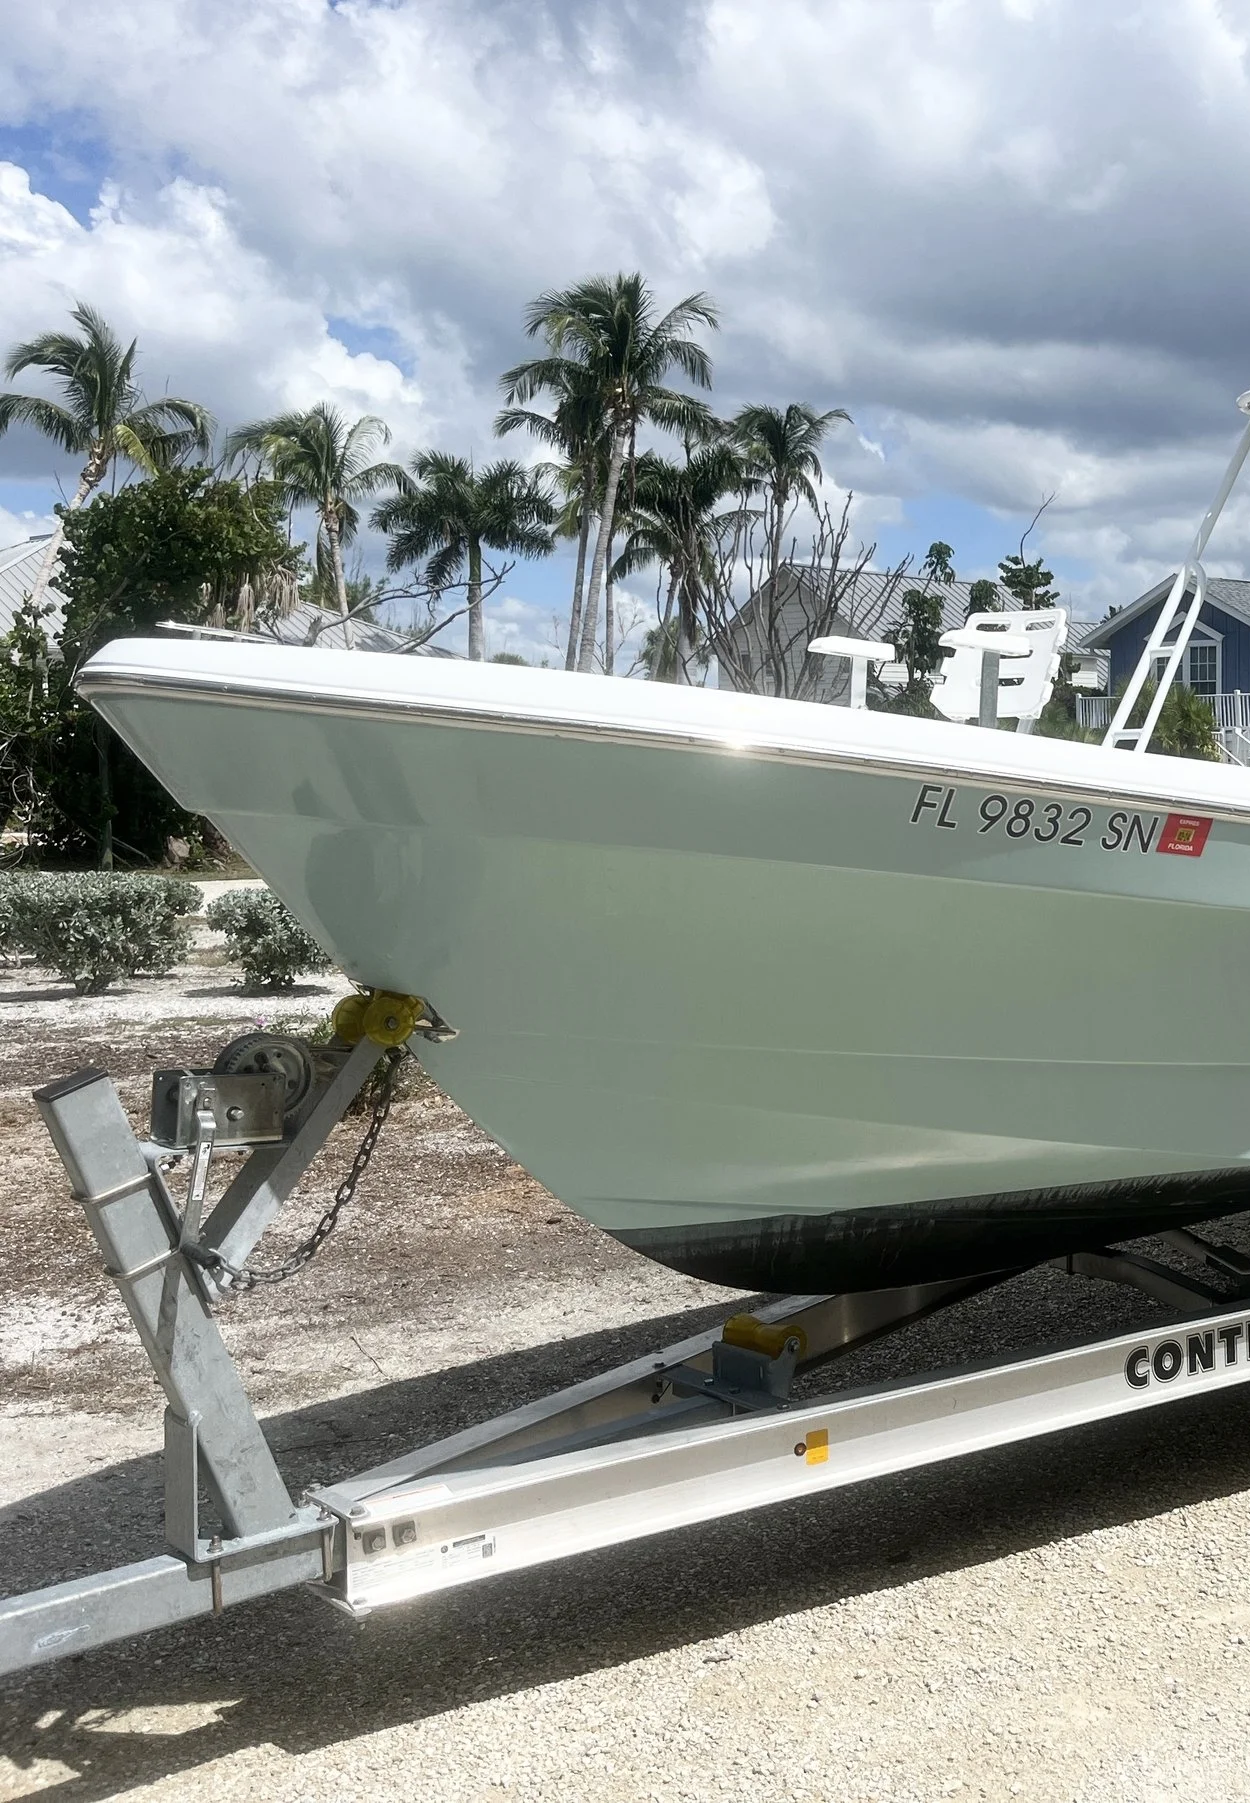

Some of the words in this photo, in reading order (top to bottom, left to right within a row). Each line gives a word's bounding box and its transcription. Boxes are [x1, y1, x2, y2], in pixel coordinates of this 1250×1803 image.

[910, 784, 957, 829] FL
[977, 794, 1092, 847] 9832
[1101, 811, 1160, 854] SN
[1168, 843, 1193, 851] FLORIDA
